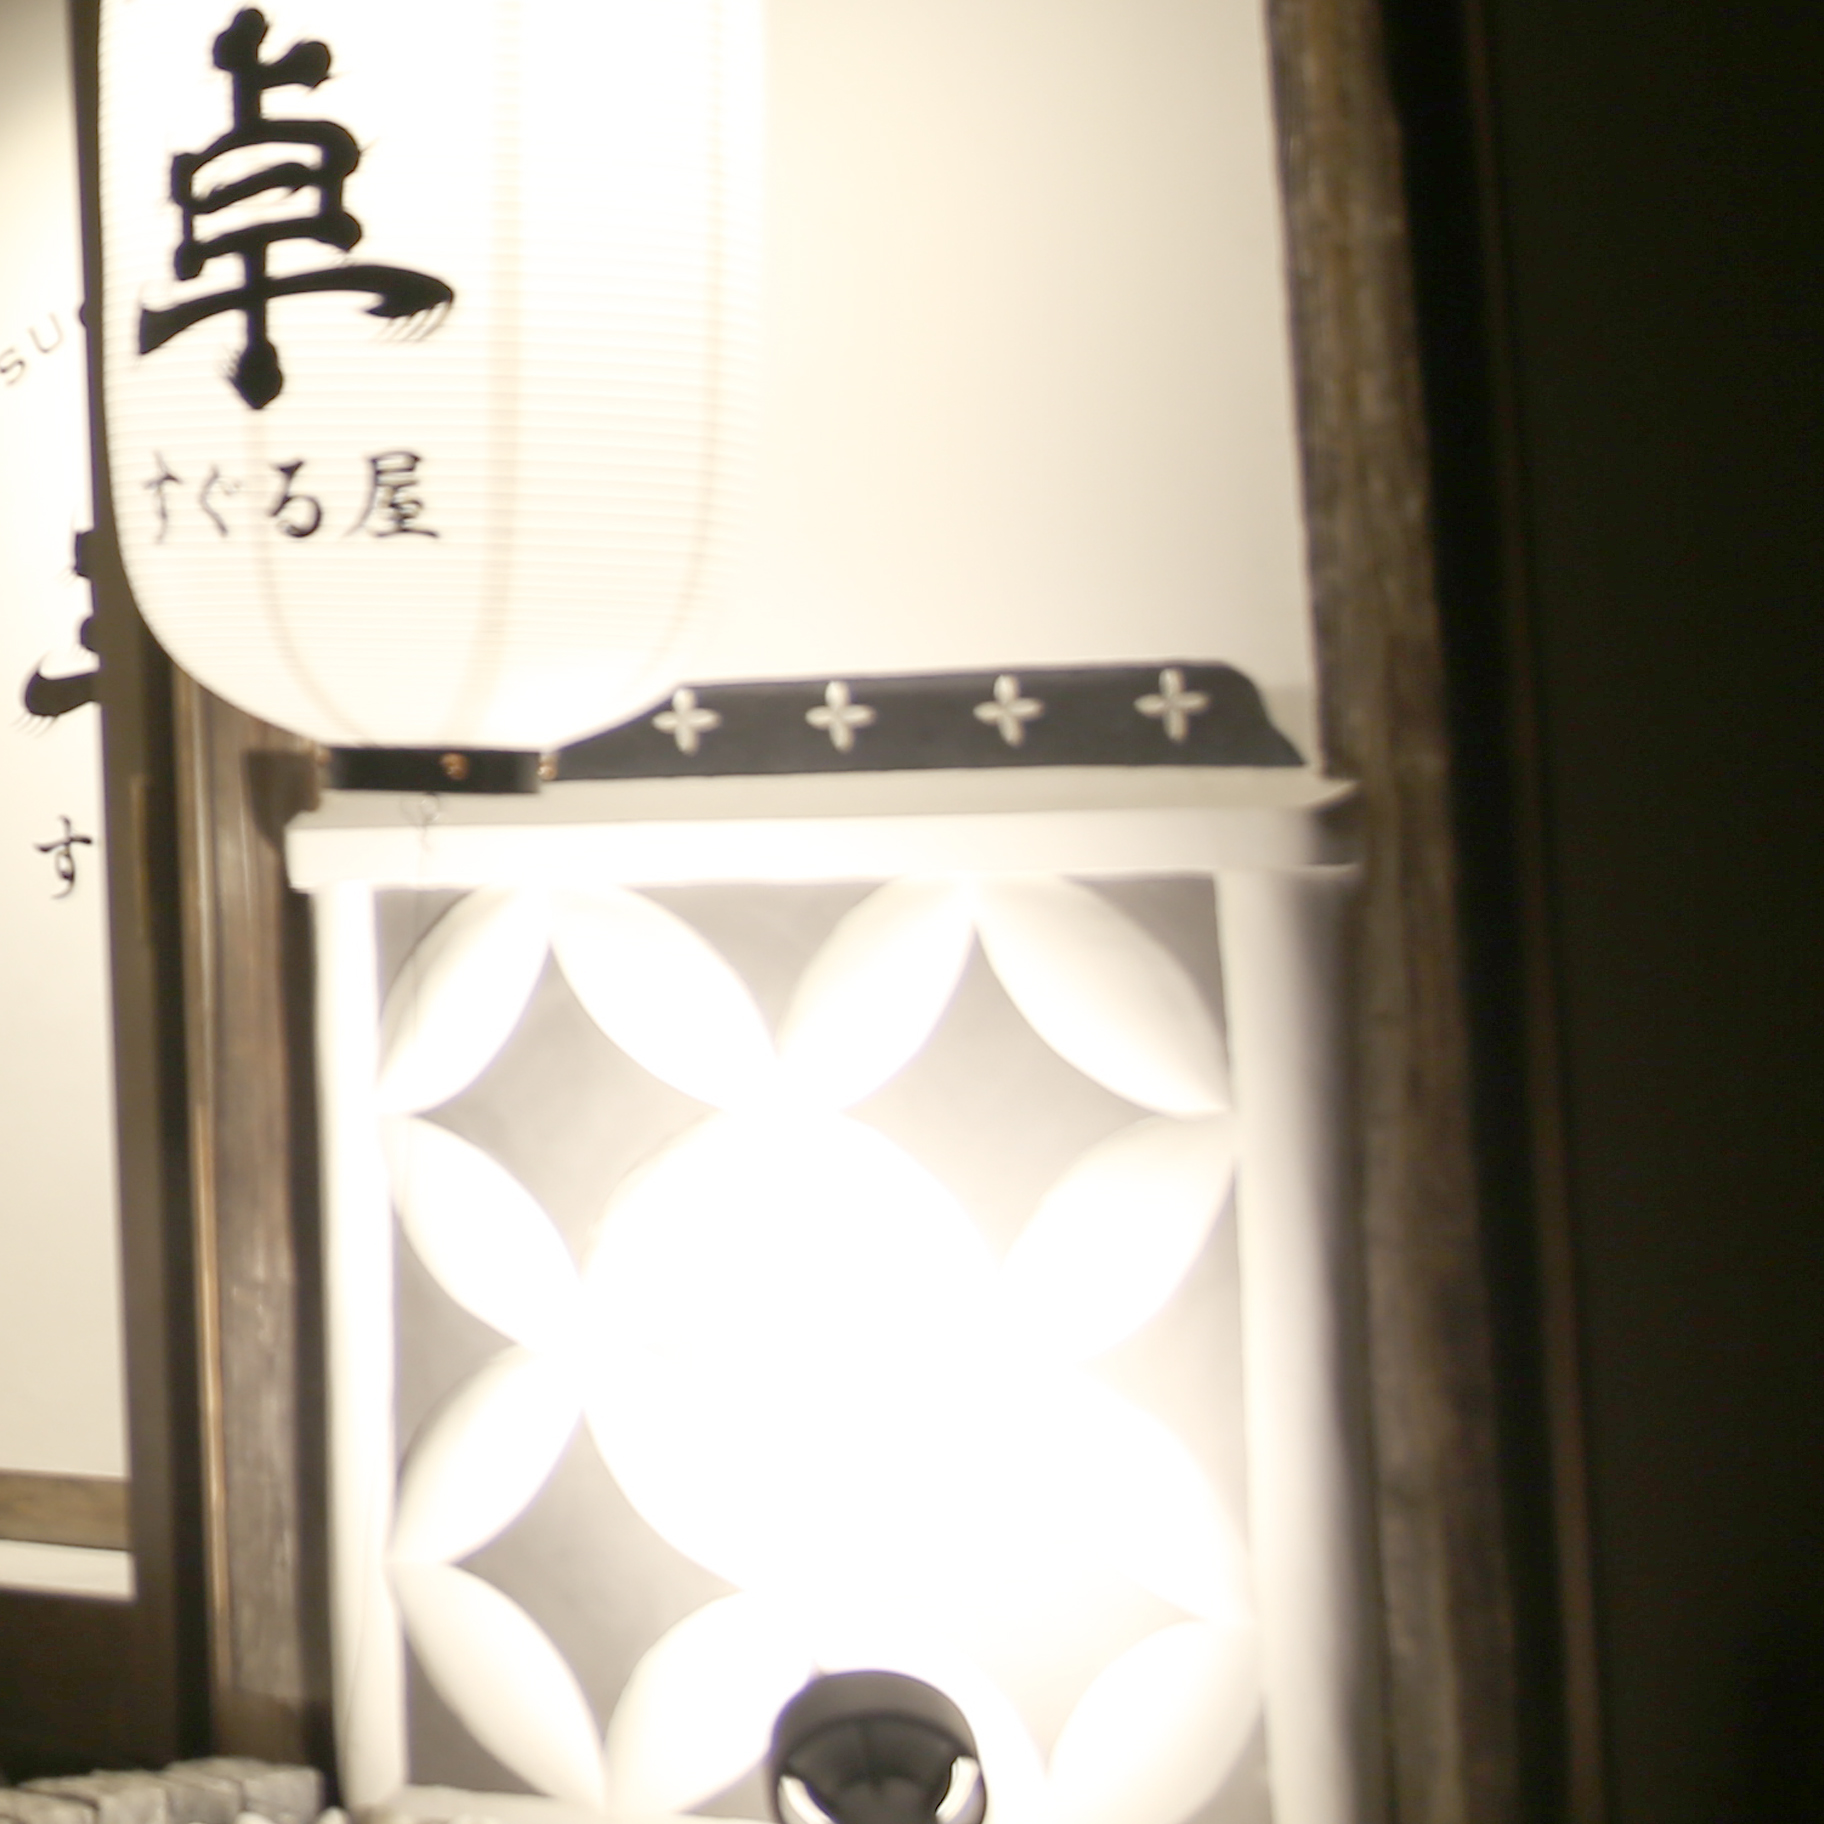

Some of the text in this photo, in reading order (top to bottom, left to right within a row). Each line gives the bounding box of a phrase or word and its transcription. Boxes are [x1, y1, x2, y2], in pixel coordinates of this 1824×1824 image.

[137, 6, 456, 412] 卓
[140, 450, 440, 543] すぐる屋
